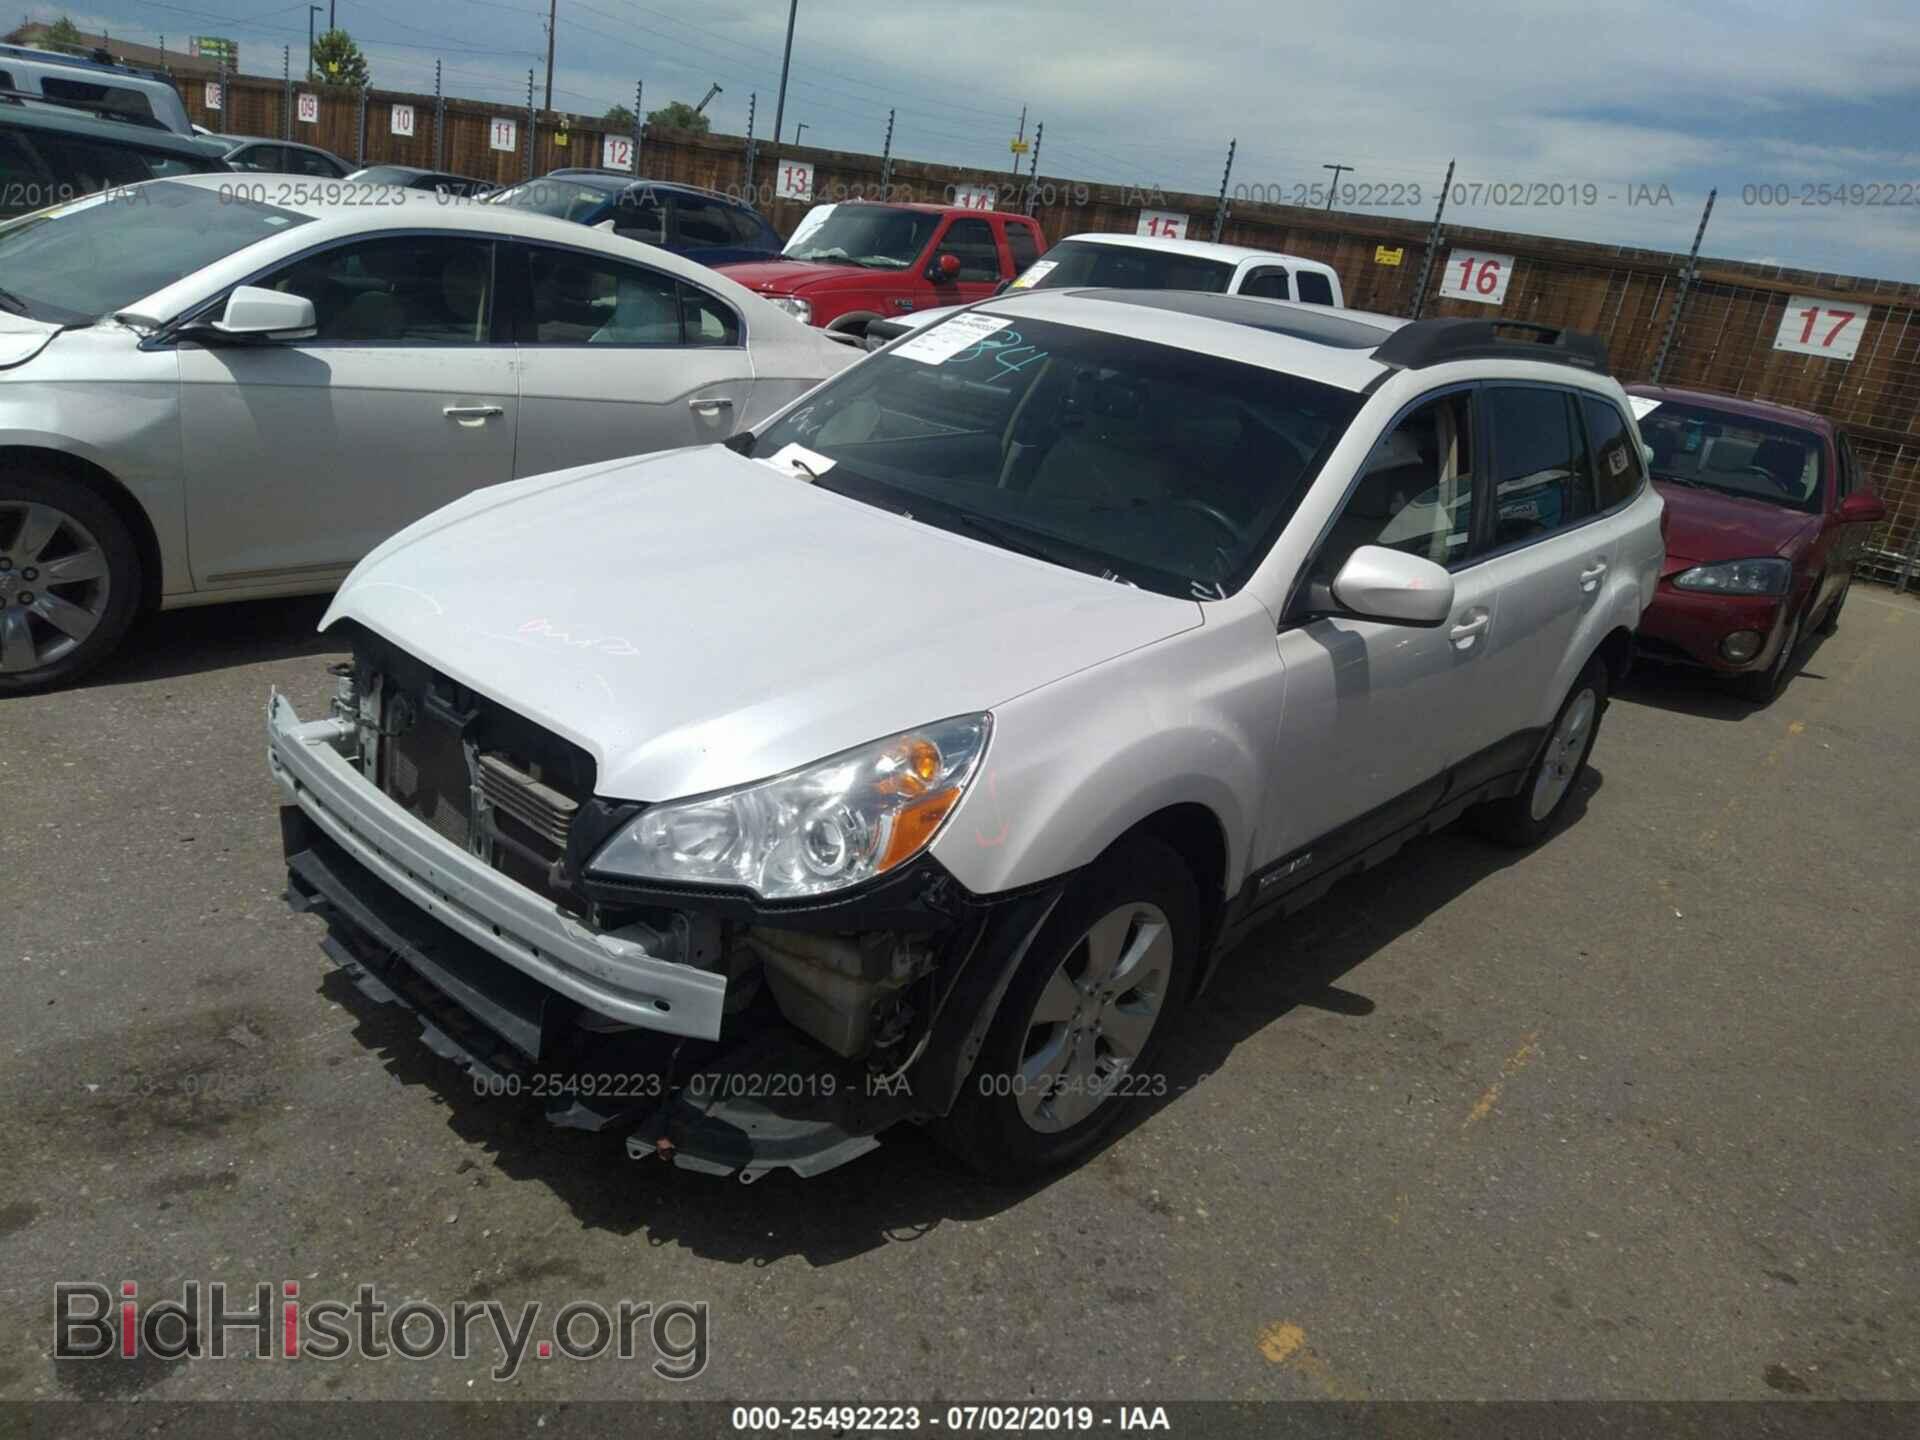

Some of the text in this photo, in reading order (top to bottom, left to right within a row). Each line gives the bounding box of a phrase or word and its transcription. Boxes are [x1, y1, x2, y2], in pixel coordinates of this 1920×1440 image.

[396, 109, 410, 130] 10
[496, 122, 511, 145] 11
[609, 140, 629, 165] 12
[784, 165, 807, 193] 13
[1148, 217, 1179, 239] 15
[1459, 256, 1501, 295] 16
[1799, 306, 1856, 348] 17
